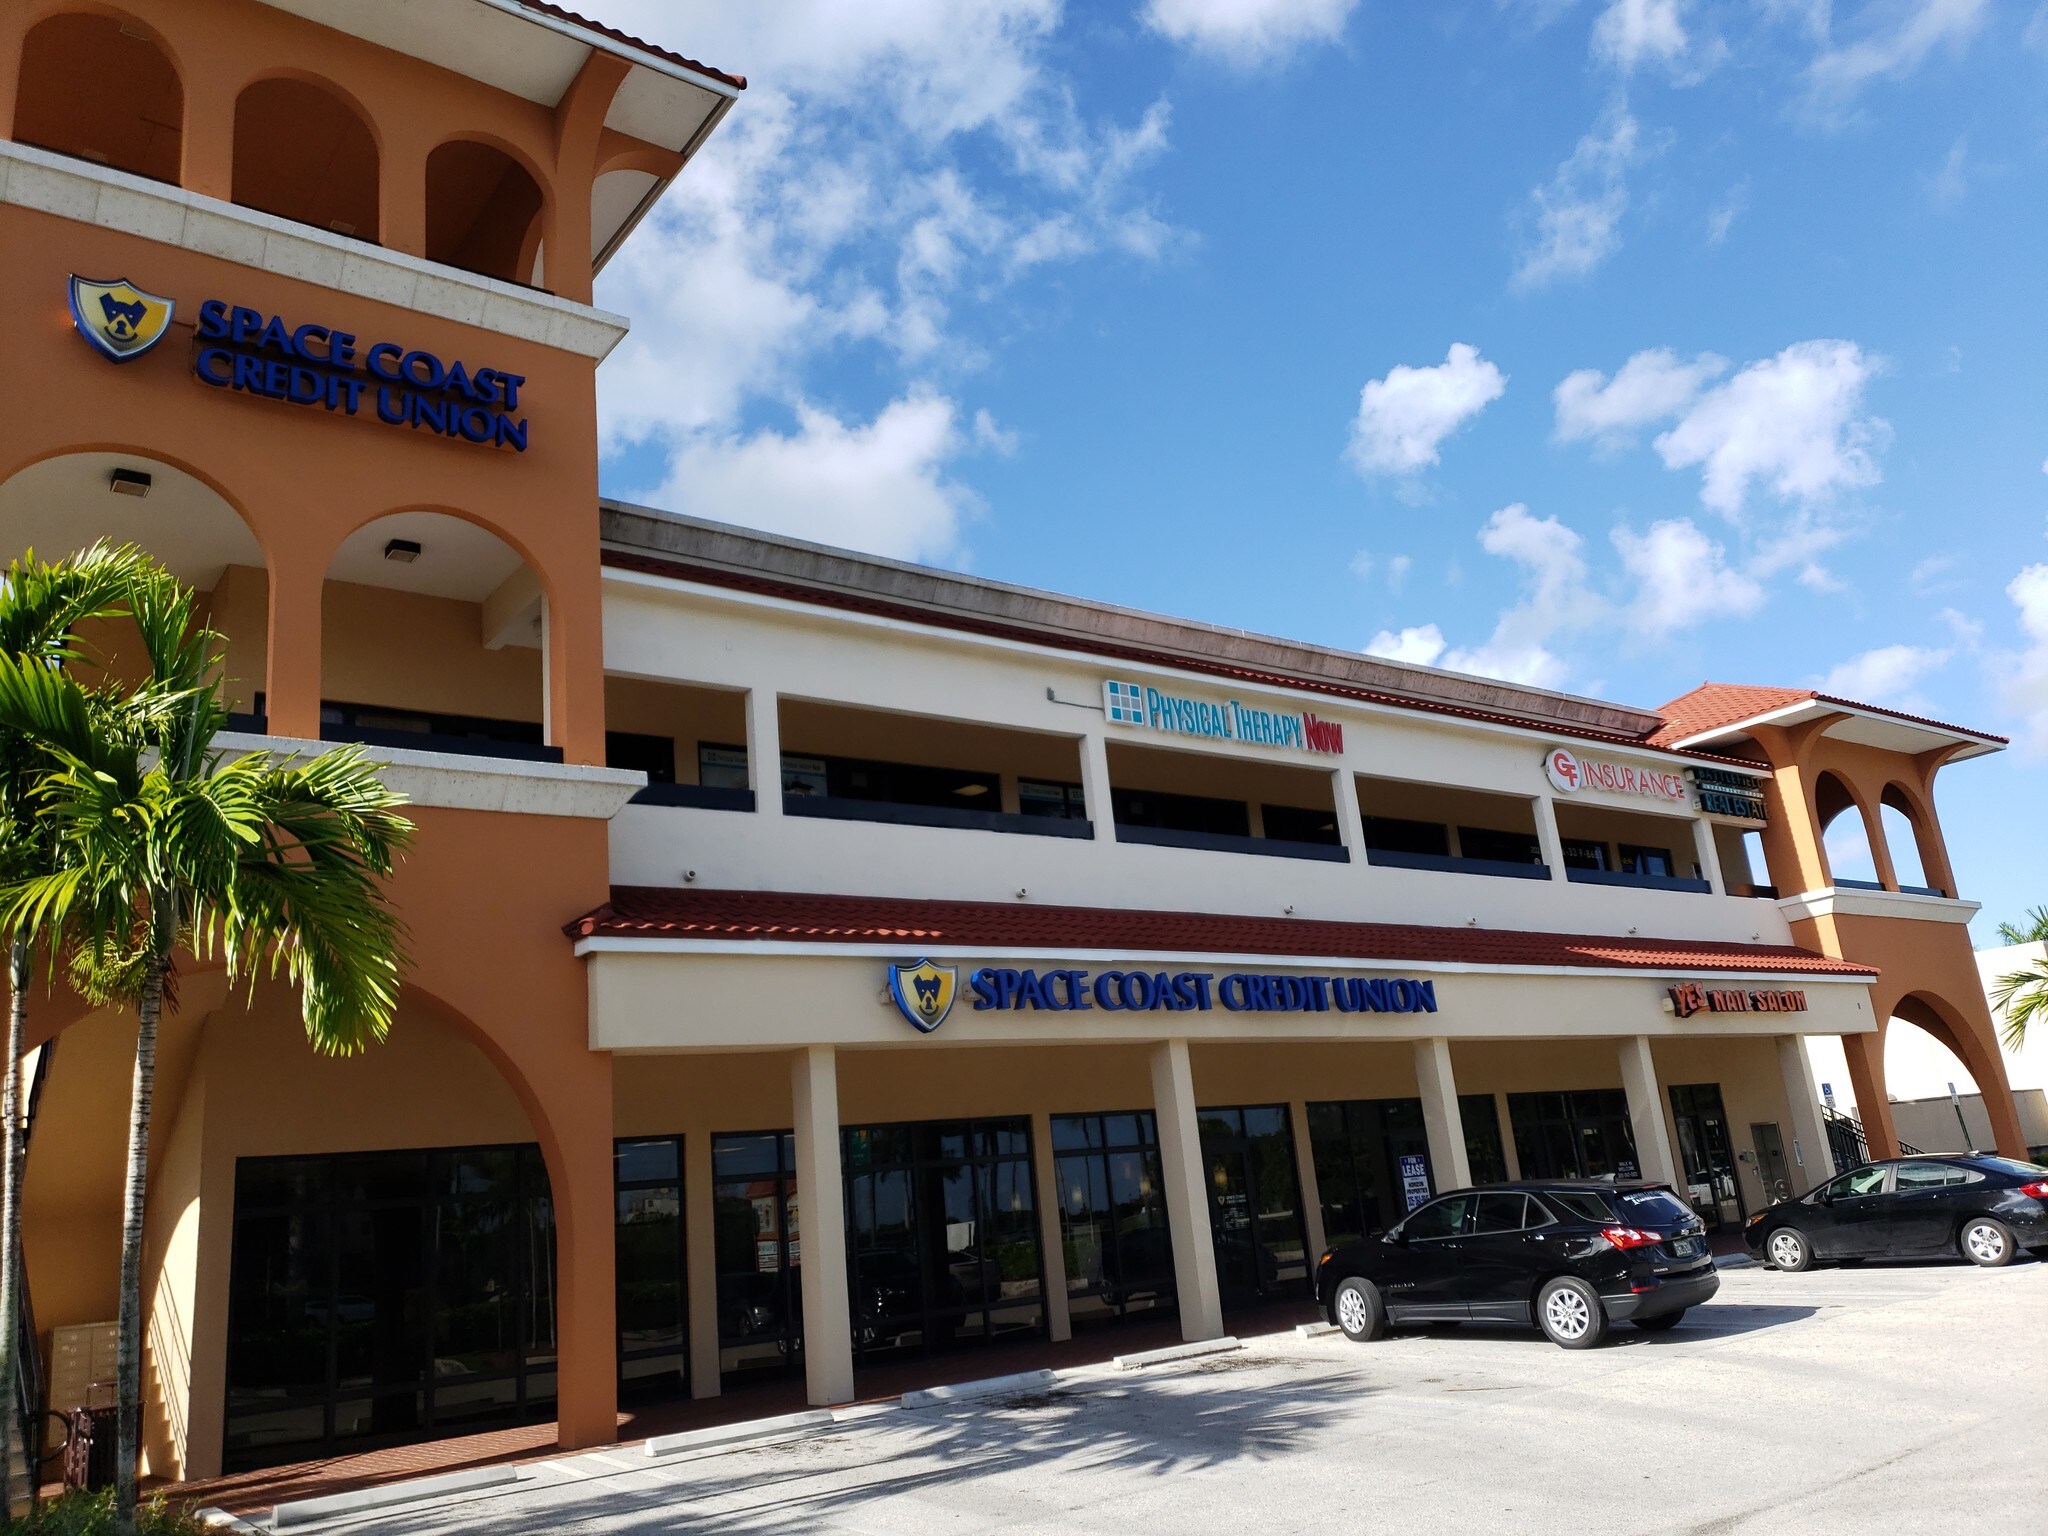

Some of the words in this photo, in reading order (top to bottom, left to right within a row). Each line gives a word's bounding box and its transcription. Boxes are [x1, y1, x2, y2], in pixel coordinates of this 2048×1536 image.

[199, 299, 356, 369] SPACE
[366, 342, 526, 412] COAST
[196, 347, 366, 415] CREDIT
[376, 386, 528, 452] UNION
[1146, 687, 1232, 739] PHYSICAL
[1230, 701, 1300, 747] THERAPY
[1302, 712, 1344, 754] NOW
[1582, 760, 1686, 799] INSURANCE
[1697, 767, 1763, 788] BATTLEFIELD
[1705, 794, 1733, 815] REAL
[971, 968, 1093, 1011] SPACE
[1094, 970, 1214, 1011] COAST
[1218, 973, 1330, 1012] CREDIT
[1331, 977, 1438, 1013] UNION
[1671, 981, 1705, 1017] YES
[1708, 990, 1753, 1012] NAIL
[1752, 990, 1808, 1012] SALON
[1402, 1164, 1426, 1177] LEASE
